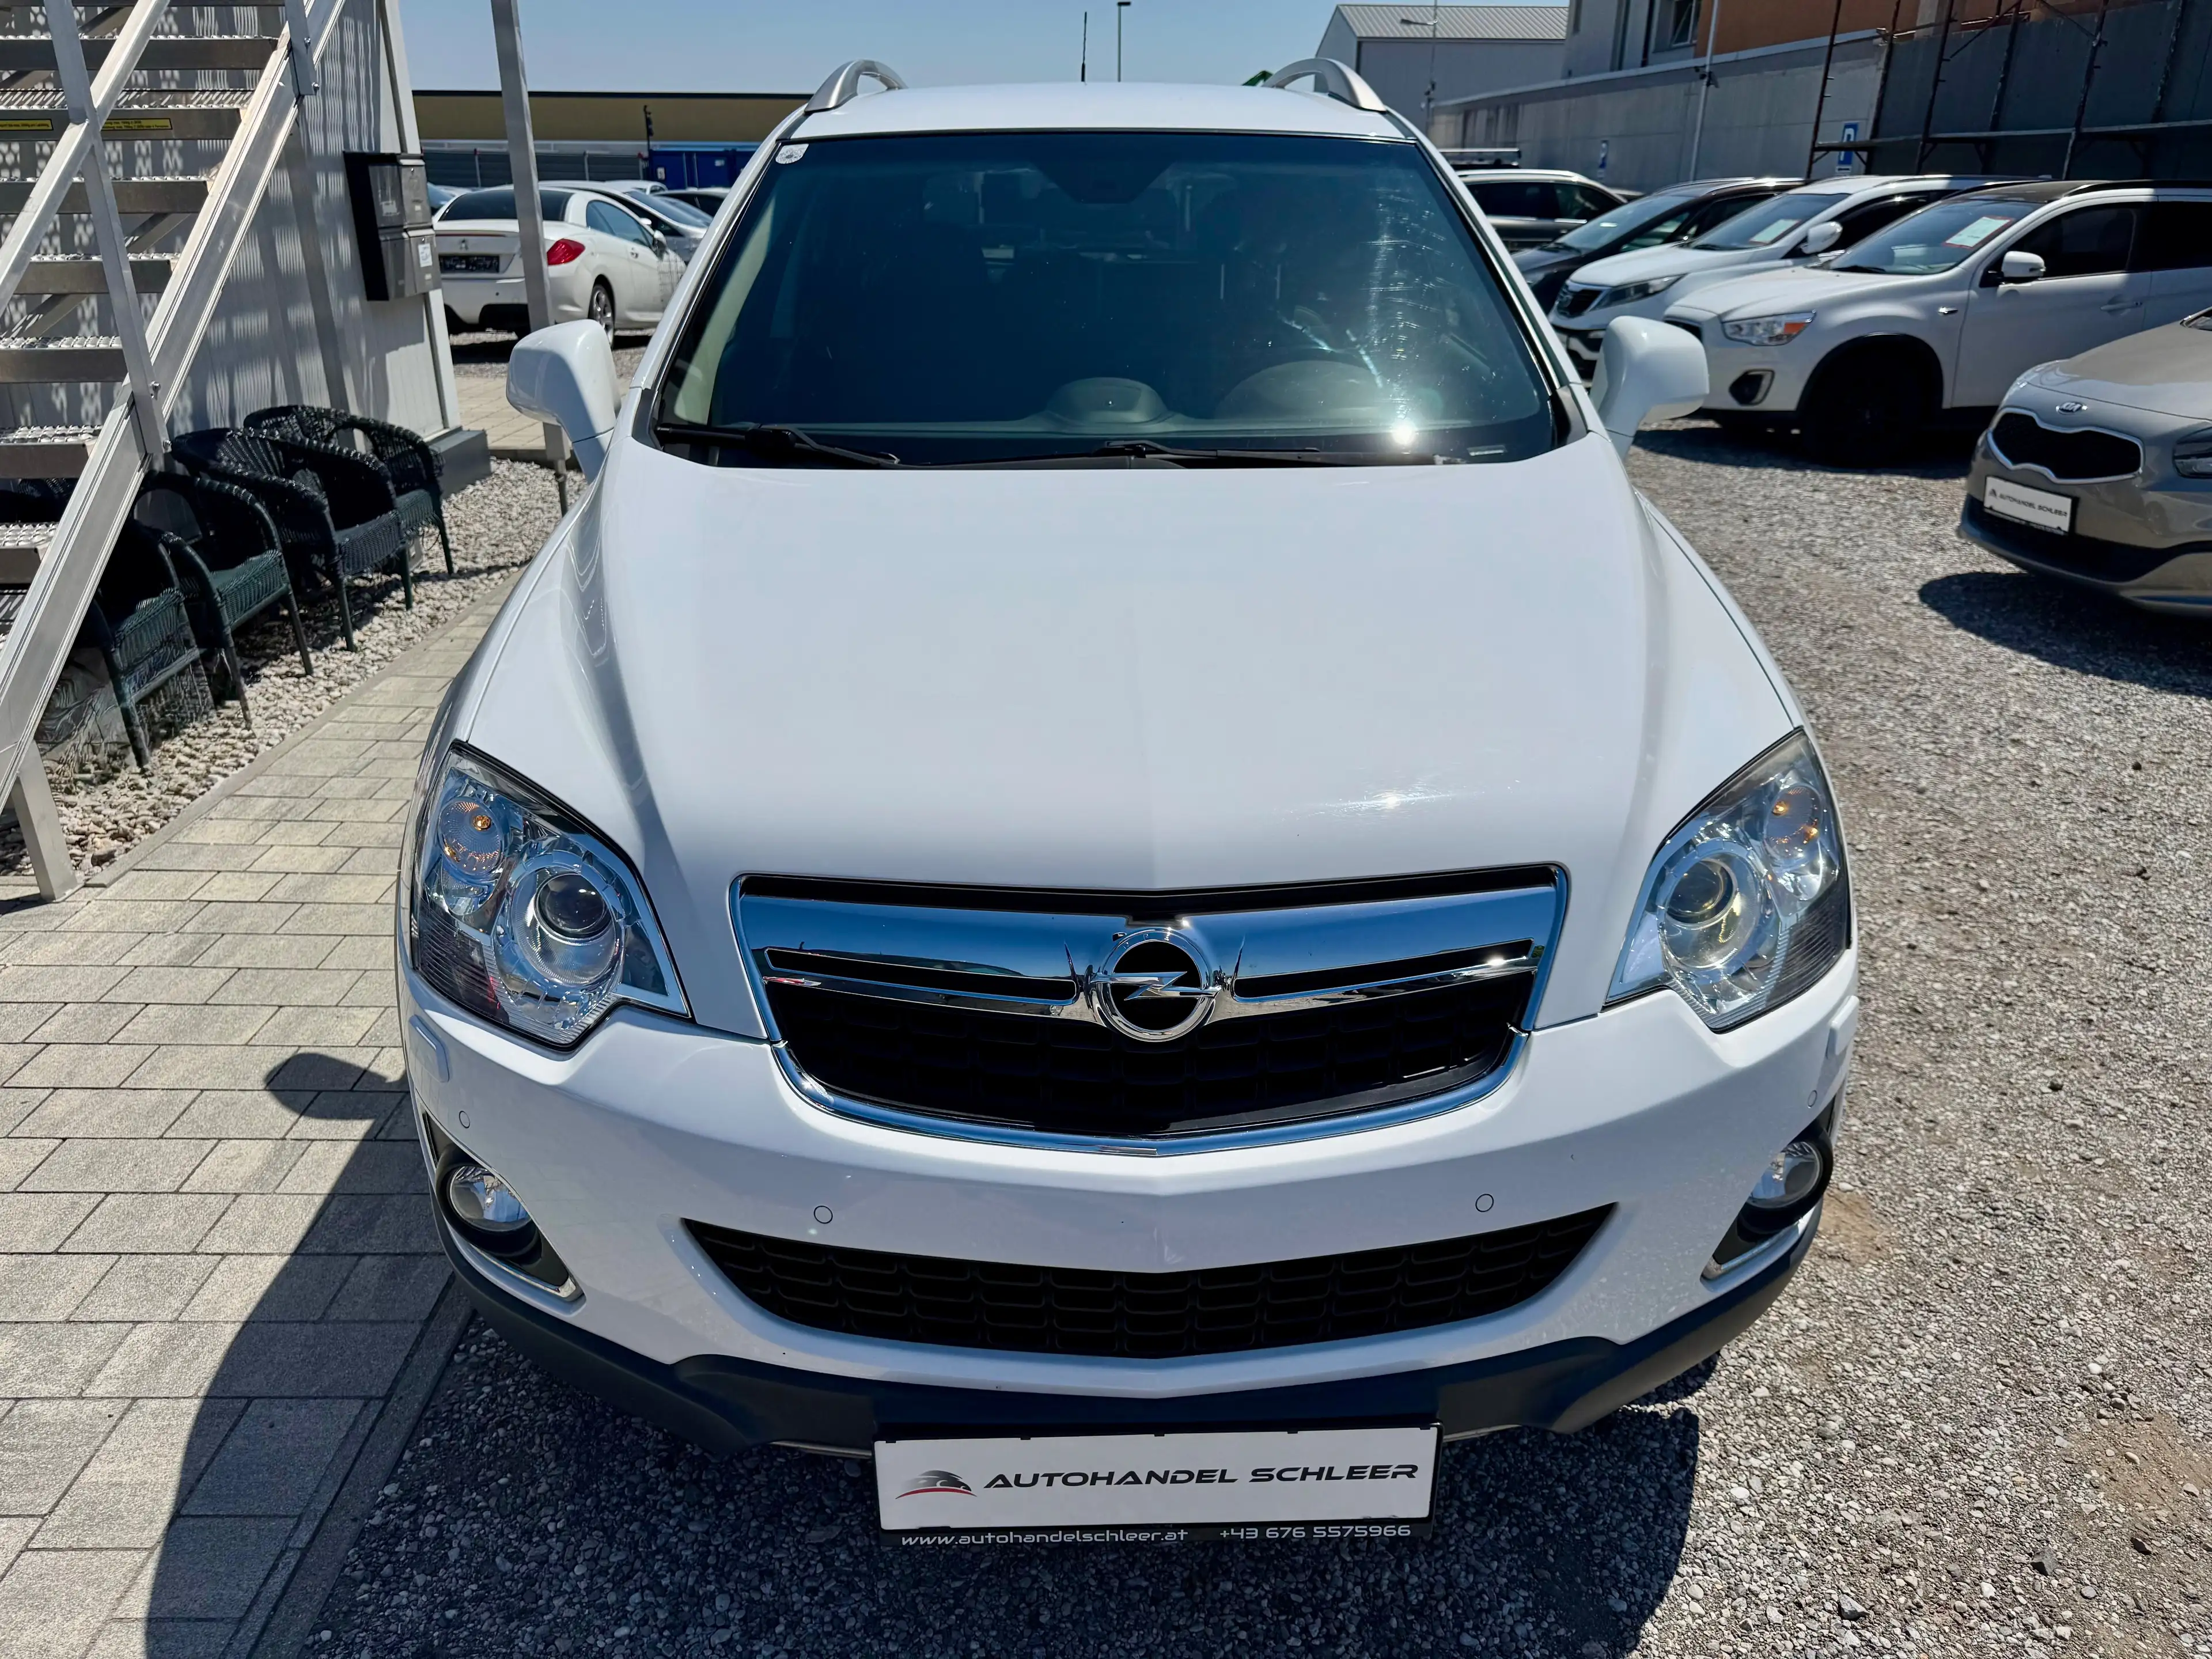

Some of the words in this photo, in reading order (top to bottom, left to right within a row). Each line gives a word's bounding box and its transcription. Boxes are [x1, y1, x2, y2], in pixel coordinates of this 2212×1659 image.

[983, 1469, 1238, 1488] AUTOHANDEL
[1248, 1464, 1419, 1483] SCHLEER
[902, 1529, 1188, 1546] www.autohandelschleer.at
[1219, 1528, 1258, 1539] +43
[1266, 1527, 1306, 1538] 676
[1312, 1525, 1411, 1537] 5575966
